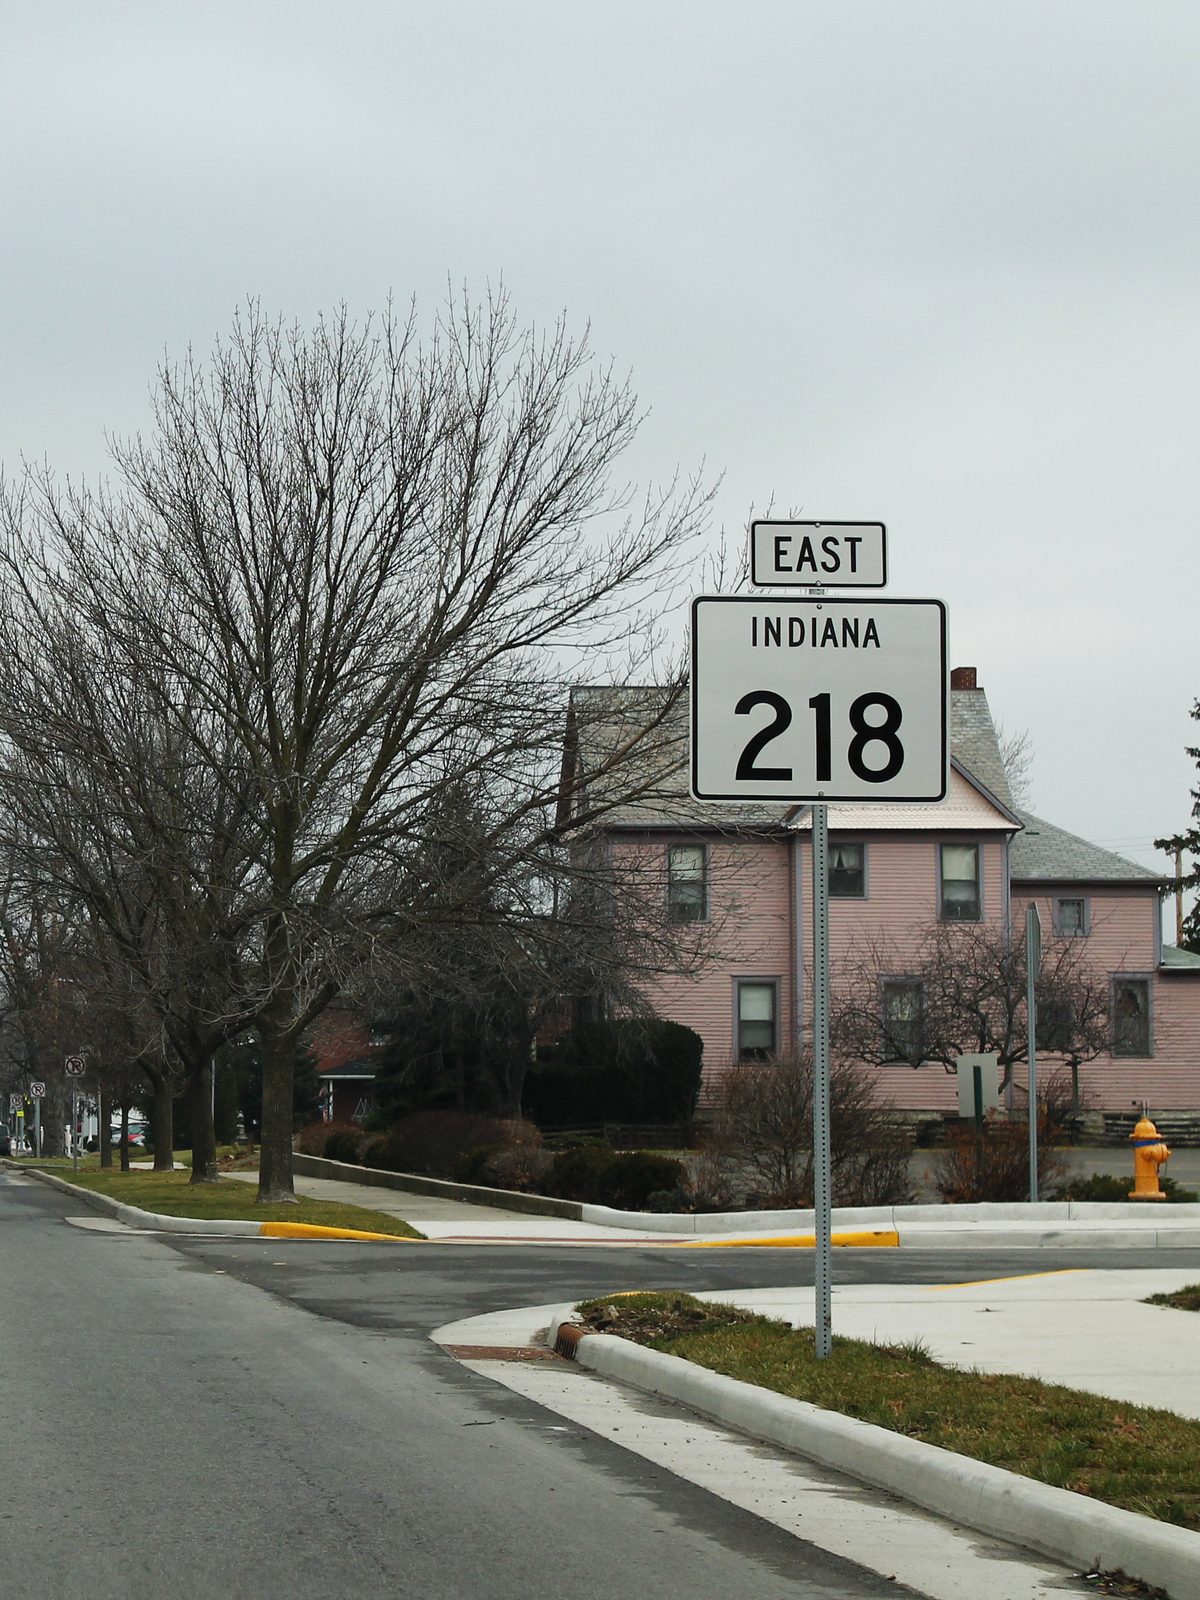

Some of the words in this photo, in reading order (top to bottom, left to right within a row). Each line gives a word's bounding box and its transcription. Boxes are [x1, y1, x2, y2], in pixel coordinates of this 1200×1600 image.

[774, 536, 863, 573] EAST
[752, 616, 881, 648] INDIANA
[734, 690, 905, 783] 218
